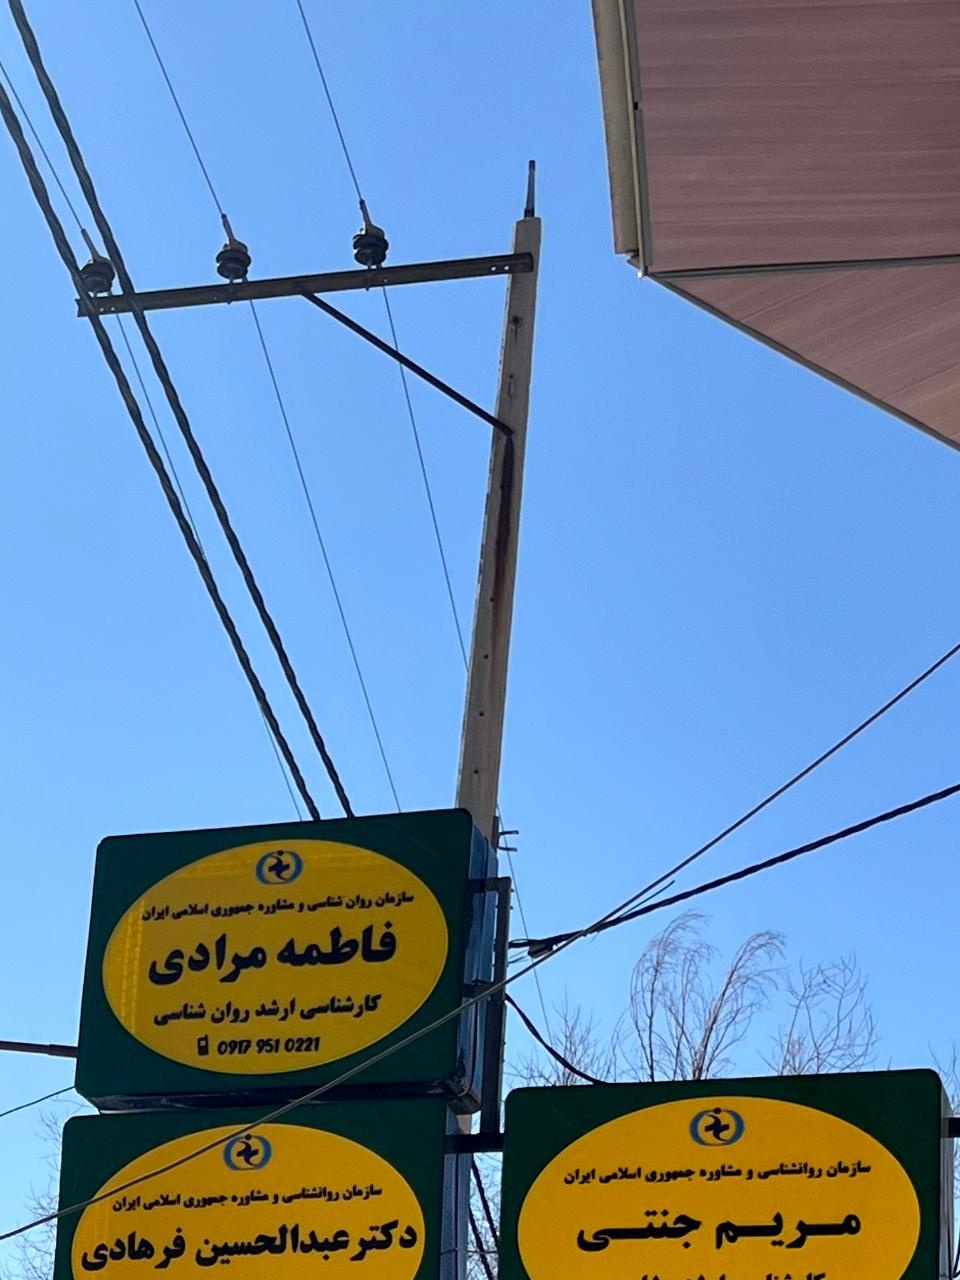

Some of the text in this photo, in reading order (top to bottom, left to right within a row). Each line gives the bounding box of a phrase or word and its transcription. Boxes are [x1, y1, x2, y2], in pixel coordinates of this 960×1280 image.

[141, 890, 415, 922] سازمان روان شناسی و مشاوره جمهوری اسلامی ایران
[147, 919, 398, 988] فاطمه مرادی
[152, 993, 383, 1028] کارشناسی ارشد روان شناسی
[255, 1036, 281, 1055] 951
[283, 1035, 321, 1054] 0221
[563, 1159, 872, 1185] سازمان روانشناسی و مشاوره جمهوری اسلامی ایران
[112, 1183, 383, 1213] سازمان روانشناسی و مشاوره جمهوری اسلامی ایران
[81, 1219, 419, 1272] دکتر عبدالحسین فرهادی
[576, 1209, 863, 1253] مریم جنتی
